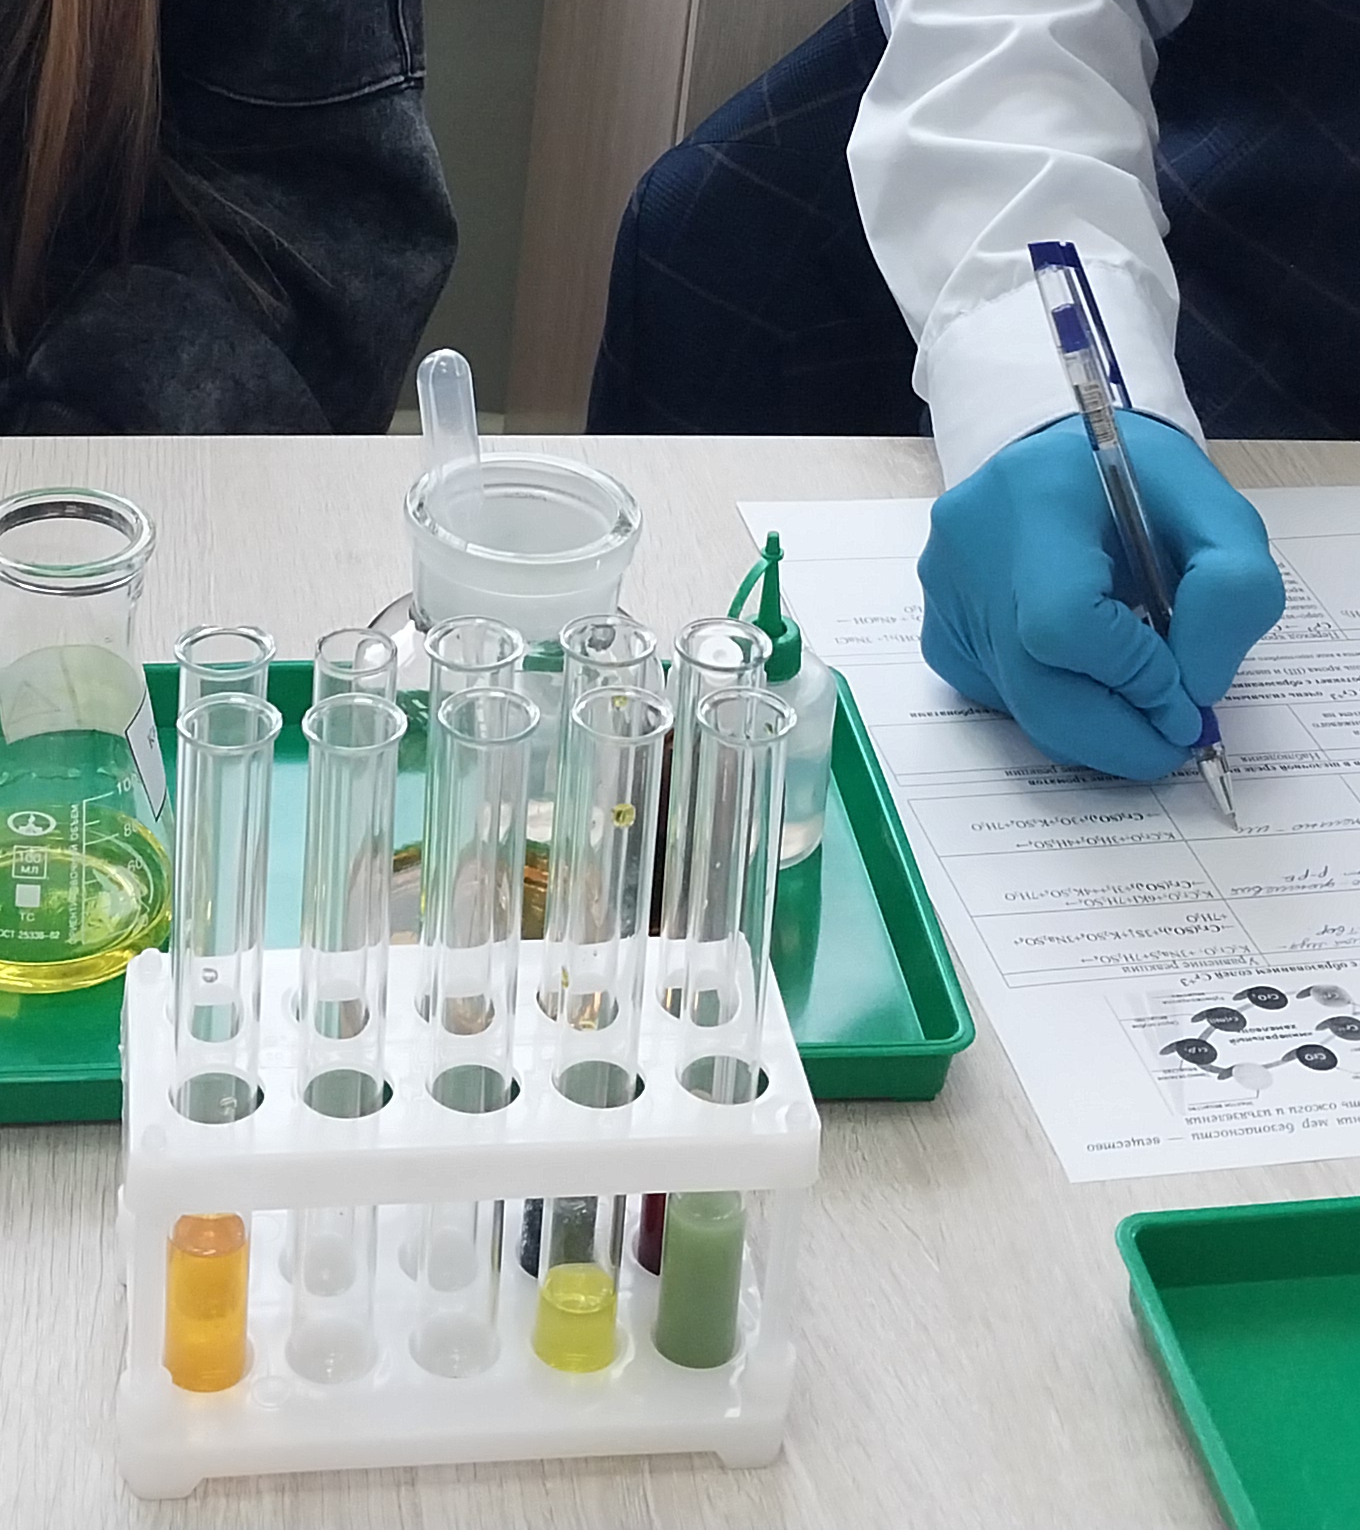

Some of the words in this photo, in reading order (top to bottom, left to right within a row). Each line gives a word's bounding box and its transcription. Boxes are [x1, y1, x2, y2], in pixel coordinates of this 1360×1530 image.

[1302, 1117, 1328, 1131] мер
[1191, 1122, 1294, 1143] безопасности
[1086, 1136, 1161, 1152] вещество
